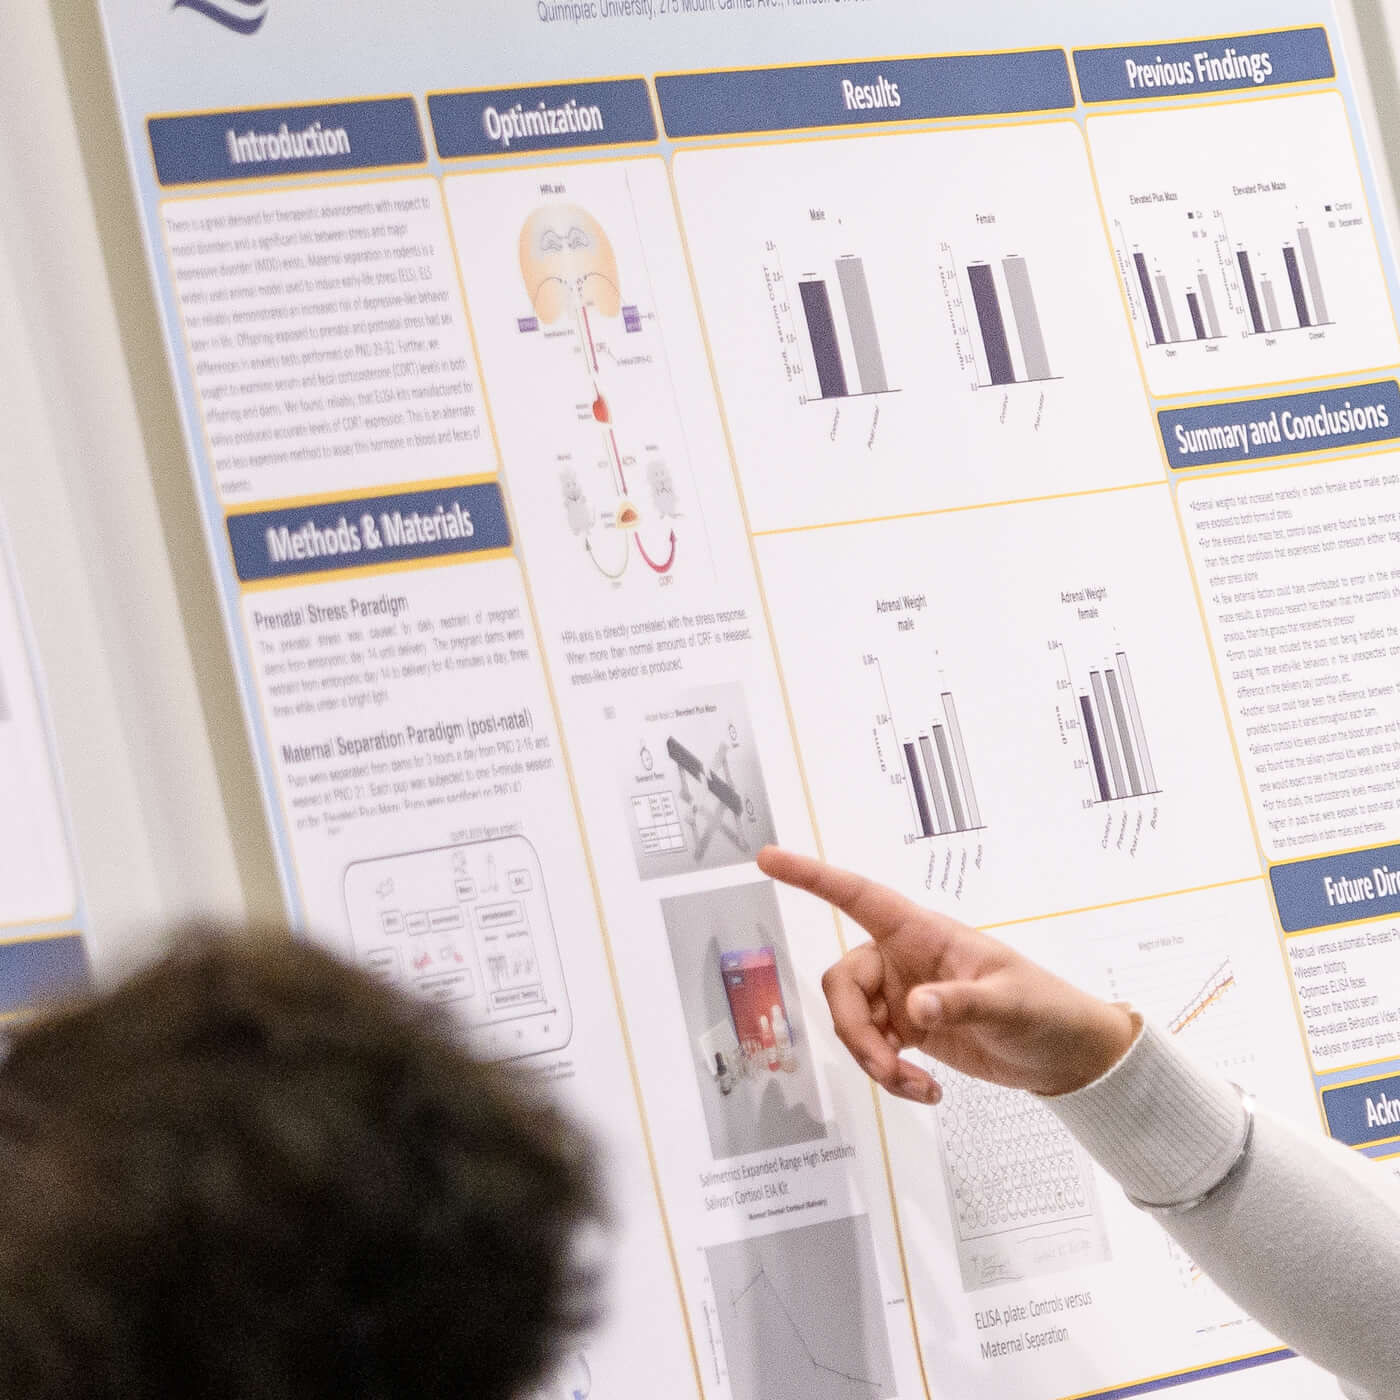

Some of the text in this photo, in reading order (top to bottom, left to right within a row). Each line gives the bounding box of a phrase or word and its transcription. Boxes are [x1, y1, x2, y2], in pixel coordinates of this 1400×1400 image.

[537, 2, 598, 24] Quinnipiac
[1125, 48, 1272, 89] Previous Findings
[842, 76, 902, 110] Results
[484, 100, 604, 146] Optimization
[228, 120, 351, 164] Introduction
[1129, 193, 1152, 205] Elevated
[1232, 181, 1287, 196] Elevated Plus Maze
[808, 207, 827, 221] Male
[1174, 401, 1389, 454] Summary and Conclusions
[266, 502, 474, 562] Methods & Materials
[876, 594, 928, 614] Adrenal Weight
[1060, 585, 1107, 604] Adrenal Weight
[254, 595, 407, 628] Prenatal Stress Paradigm
[897, 617, 915, 632] male
[1076, 606, 1100, 621] female
[282, 709, 532, 763] Maternal Separation Paradigm (post-natal)
[1323, 876, 1375, 906] Future
[1317, 942, 1337, 954] versus
[741, 1159, 778, 1178] Expanded
[778, 1156, 802, 1171] Range
[802, 1151, 820, 1167] High
[820, 1145, 854, 1162] Sensitivity
[734, 1186, 763, 1204] Cortisol
[763, 1183, 778, 1198] EIA
[975, 1308, 1001, 1329] ELISA
[1029, 1297, 1063, 1317] Controls
[1064, 1292, 1091, 1308] versus
[980, 1327, 1067, 1358] Maternal Separation
